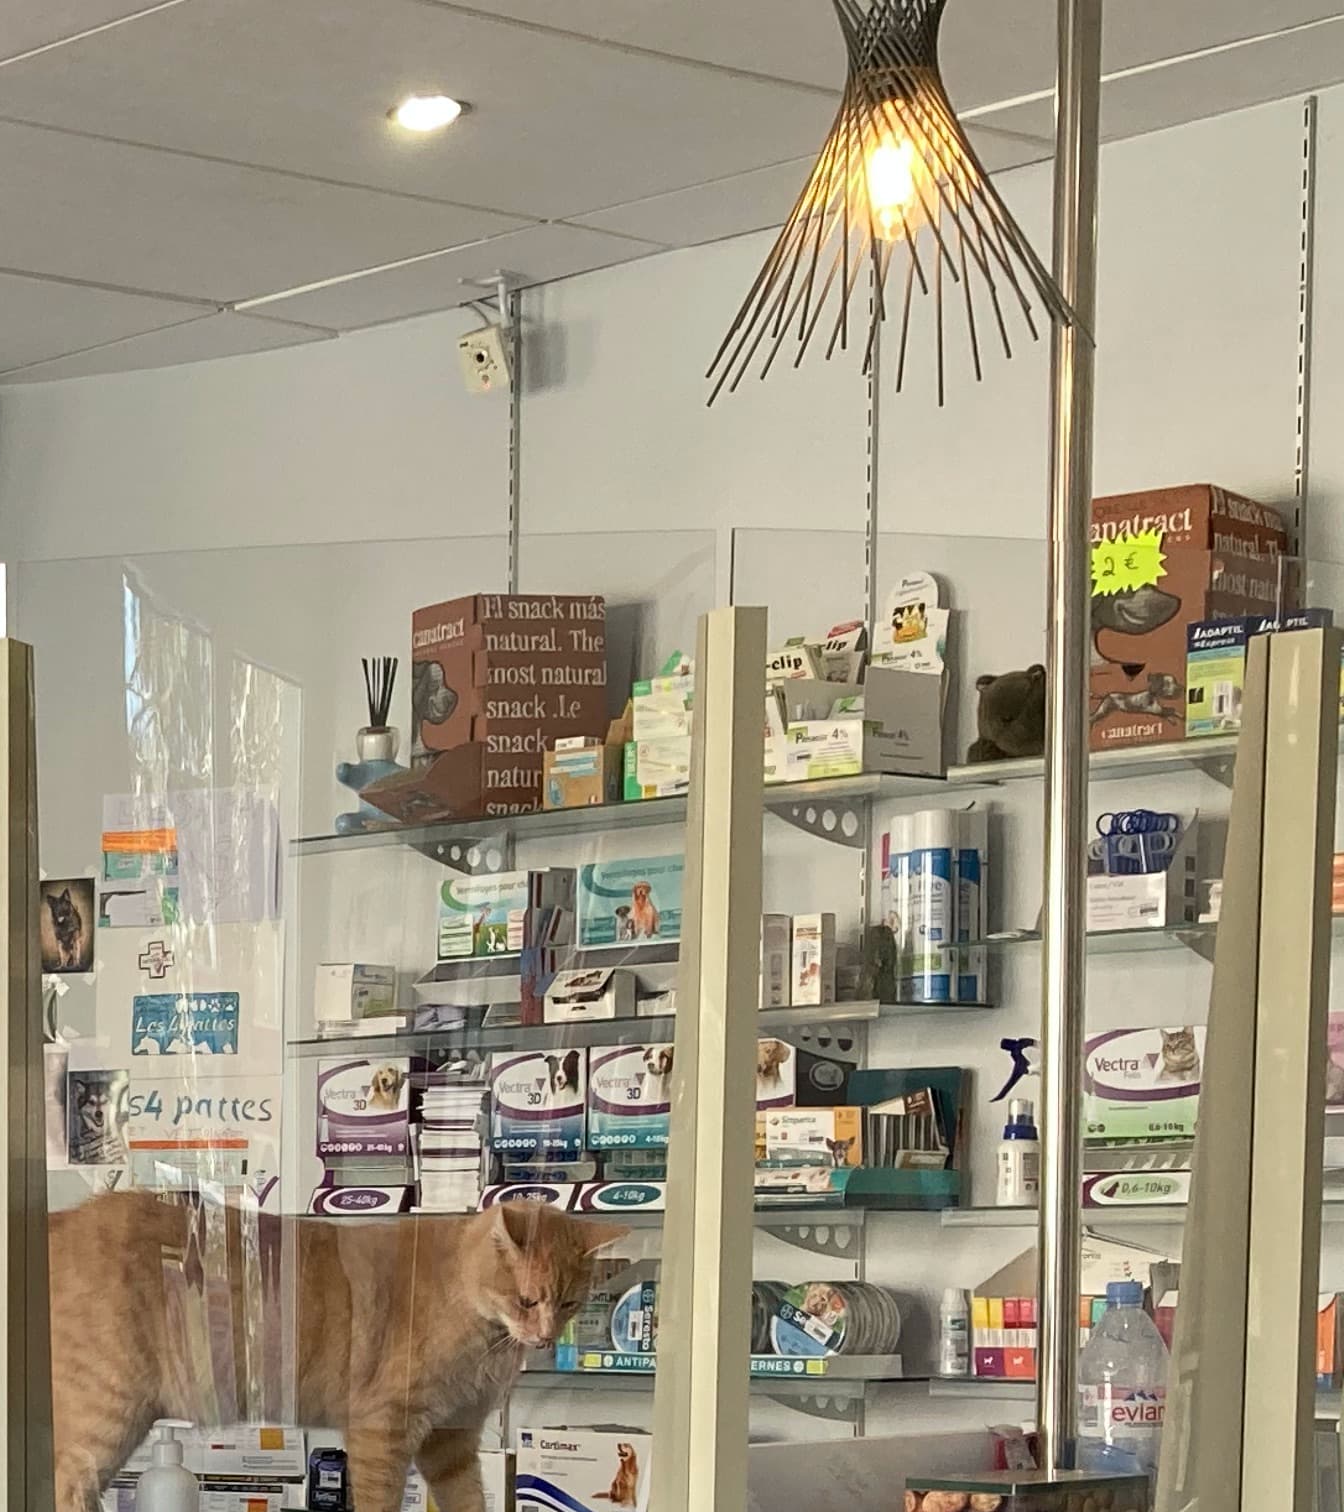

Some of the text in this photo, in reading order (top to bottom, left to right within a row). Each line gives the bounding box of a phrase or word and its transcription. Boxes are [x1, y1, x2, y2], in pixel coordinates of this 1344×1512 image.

[1091, 508, 1193, 543] anatract
[1102, 556, 1116, 577] 2
[508, 596, 564, 620] snack
[568, 630, 604, 652] The
[541, 661, 608, 686] natural
[487, 695, 546, 720] snack
[487, 729, 548, 753] snack
[1095, 1057, 1139, 1071] Vectra
[527, 1092, 542, 1105] 3D
[626, 1087, 641, 1100] 3D
[352, 1099, 367, 1111] 3D
[1121, 1182, 1172, 1194] 0,6-10kg
[643, 1305, 654, 1350] Seresto
[616, 1355, 656, 1368] ANTIPA
[751, 1360, 791, 1371] ERNES
